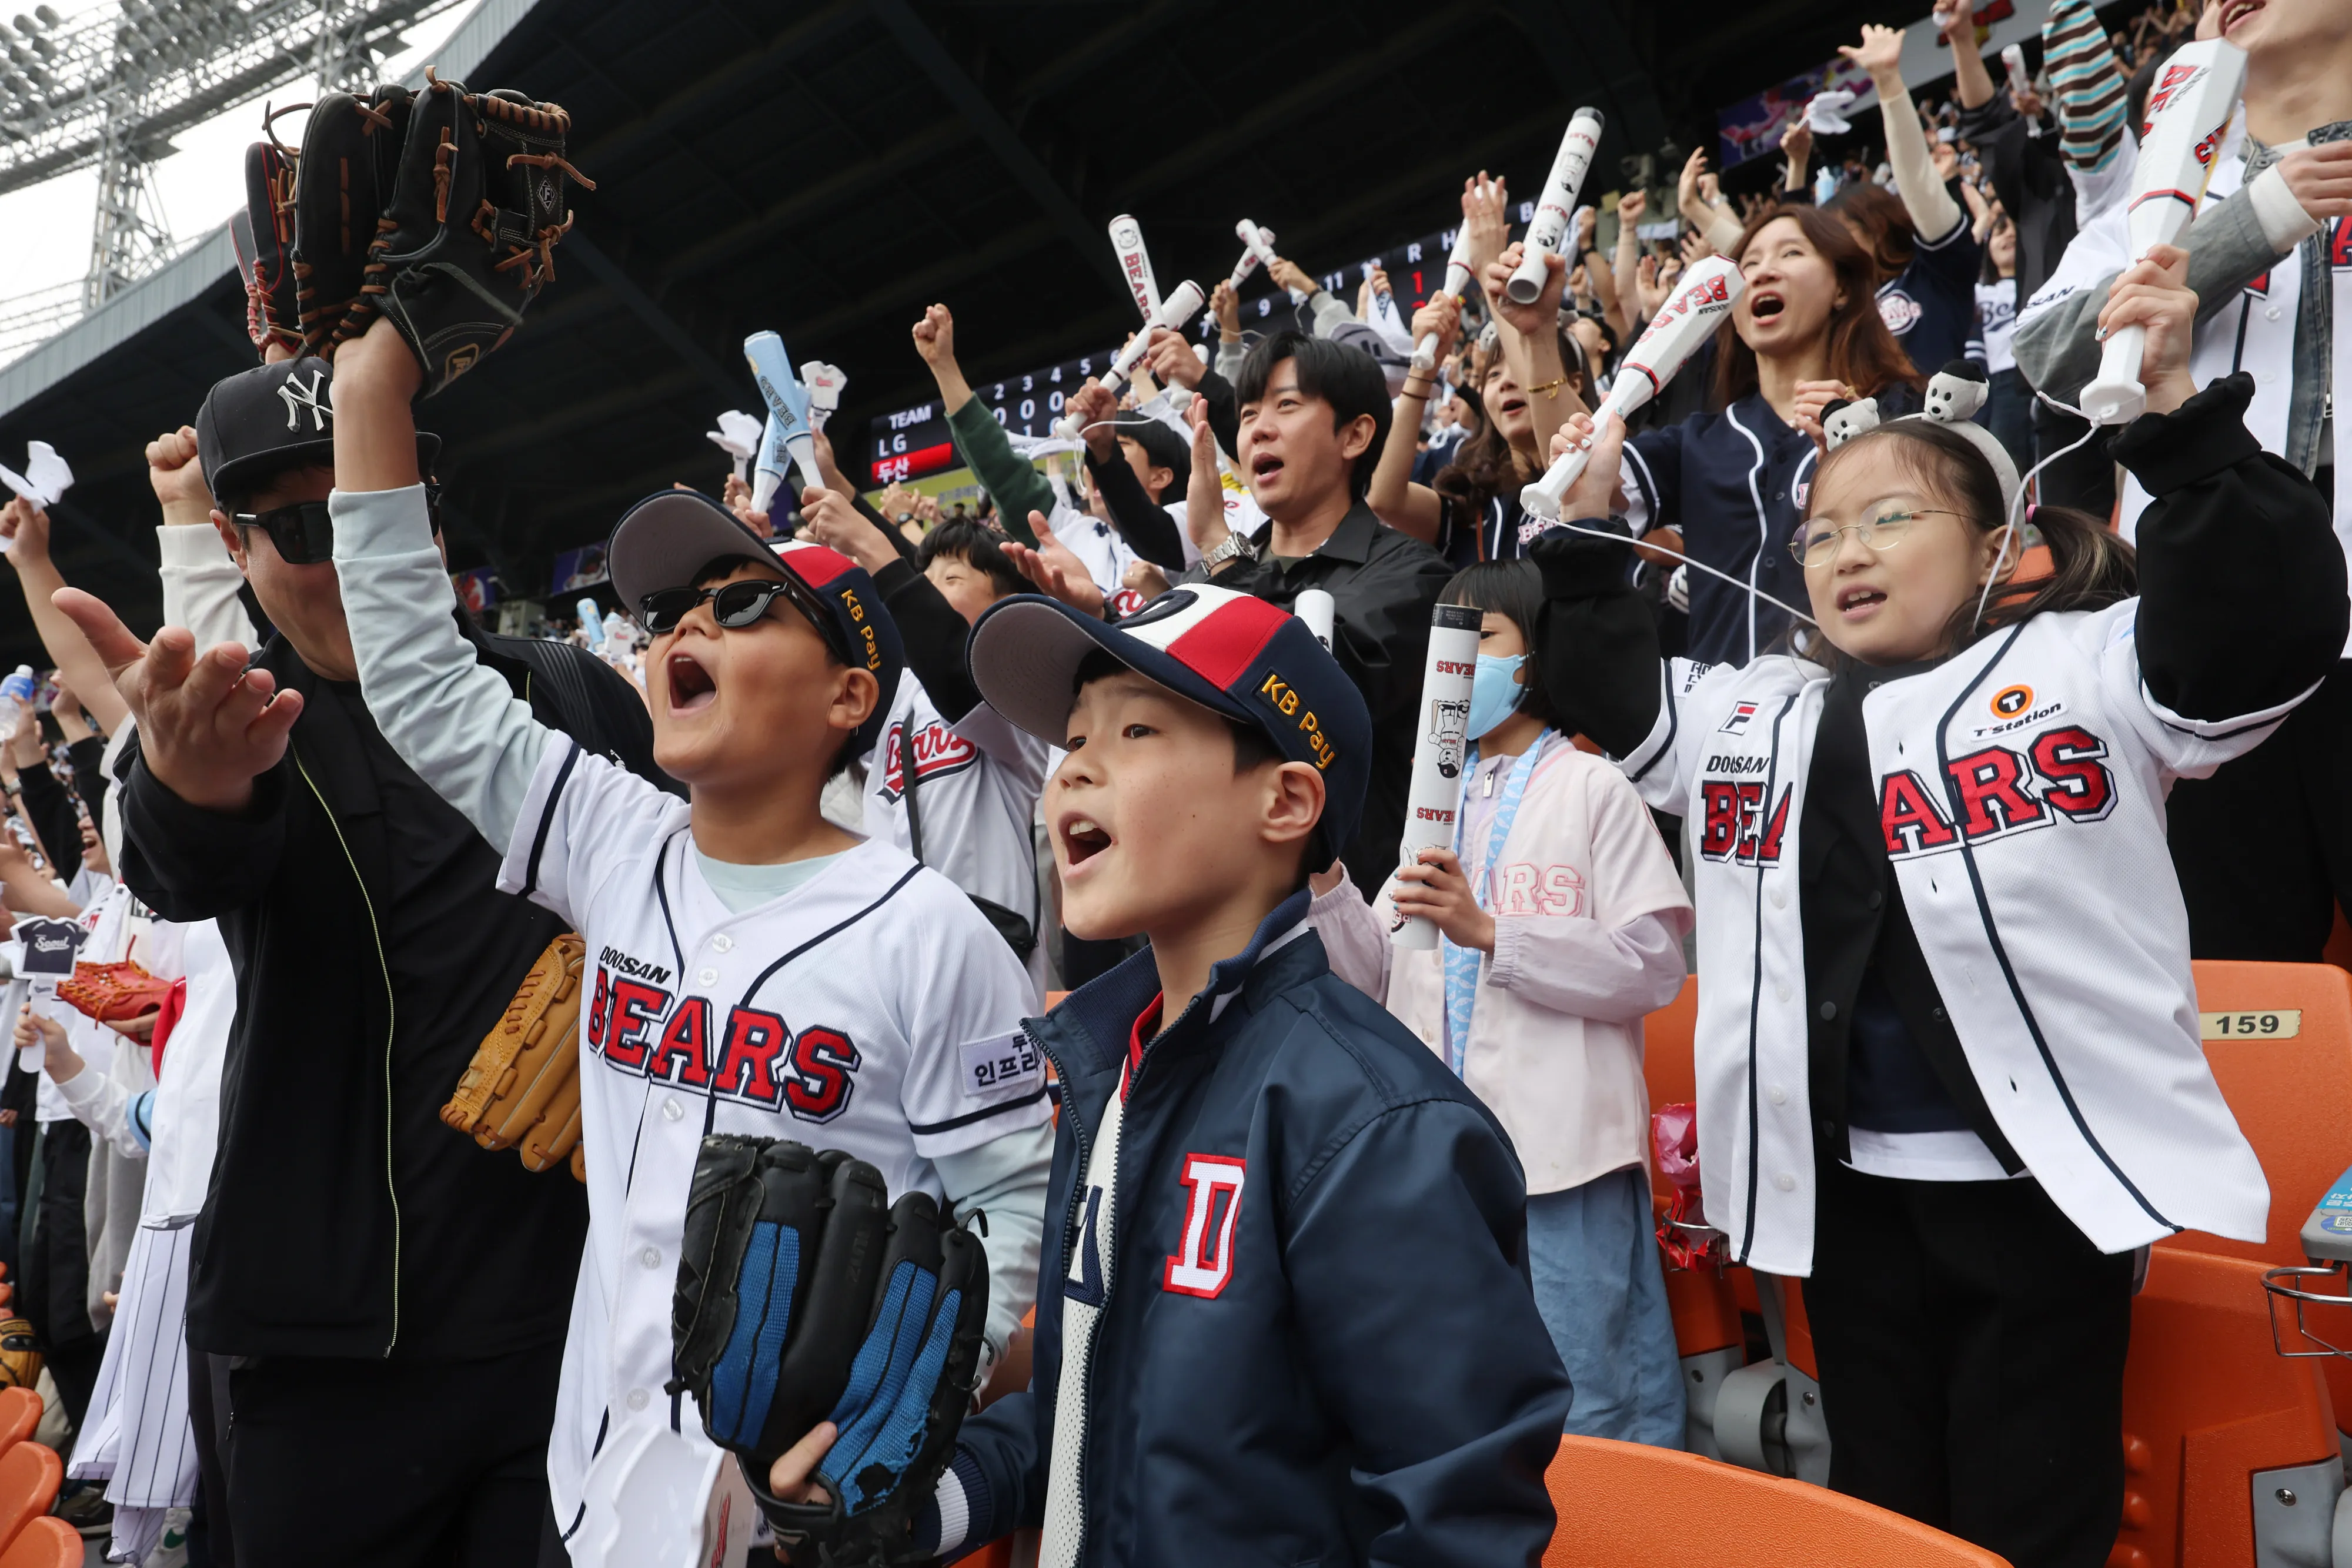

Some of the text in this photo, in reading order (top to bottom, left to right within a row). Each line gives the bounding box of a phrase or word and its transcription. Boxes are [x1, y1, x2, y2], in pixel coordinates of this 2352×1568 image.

[888, 404, 931, 430] TEAM
[994, 383, 1004, 400] 2
[1022, 375, 1033, 392] 3
[1050, 367, 1062, 382] 4
[1080, 358, 1091, 376] 5
[1258, 298, 1271, 317] 9
[1323, 271, 1344, 292] 11
[1407, 243, 1422, 263] R
[1442, 229, 1456, 251] H
[1519, 201, 1535, 223] B
[1124, 252, 1152, 321] BEARS
[1020, 399, 1035, 419] 0
[1049, 390, 1064, 412] 0
[1412, 270, 1423, 294] 1
[877, 456, 910, 483] 두산
[840, 589, 881, 671] KB Pay
[1261, 674, 1337, 770] KB Pay
[2002, 693, 2021, 711] T
[35, 936, 70, 952] Seoul
[600, 945, 670, 984] DOOSAN
[587, 962, 861, 1125] BEARS
[2216, 1015, 2280, 1035] 159
[1162, 1152, 1246, 1299] D
